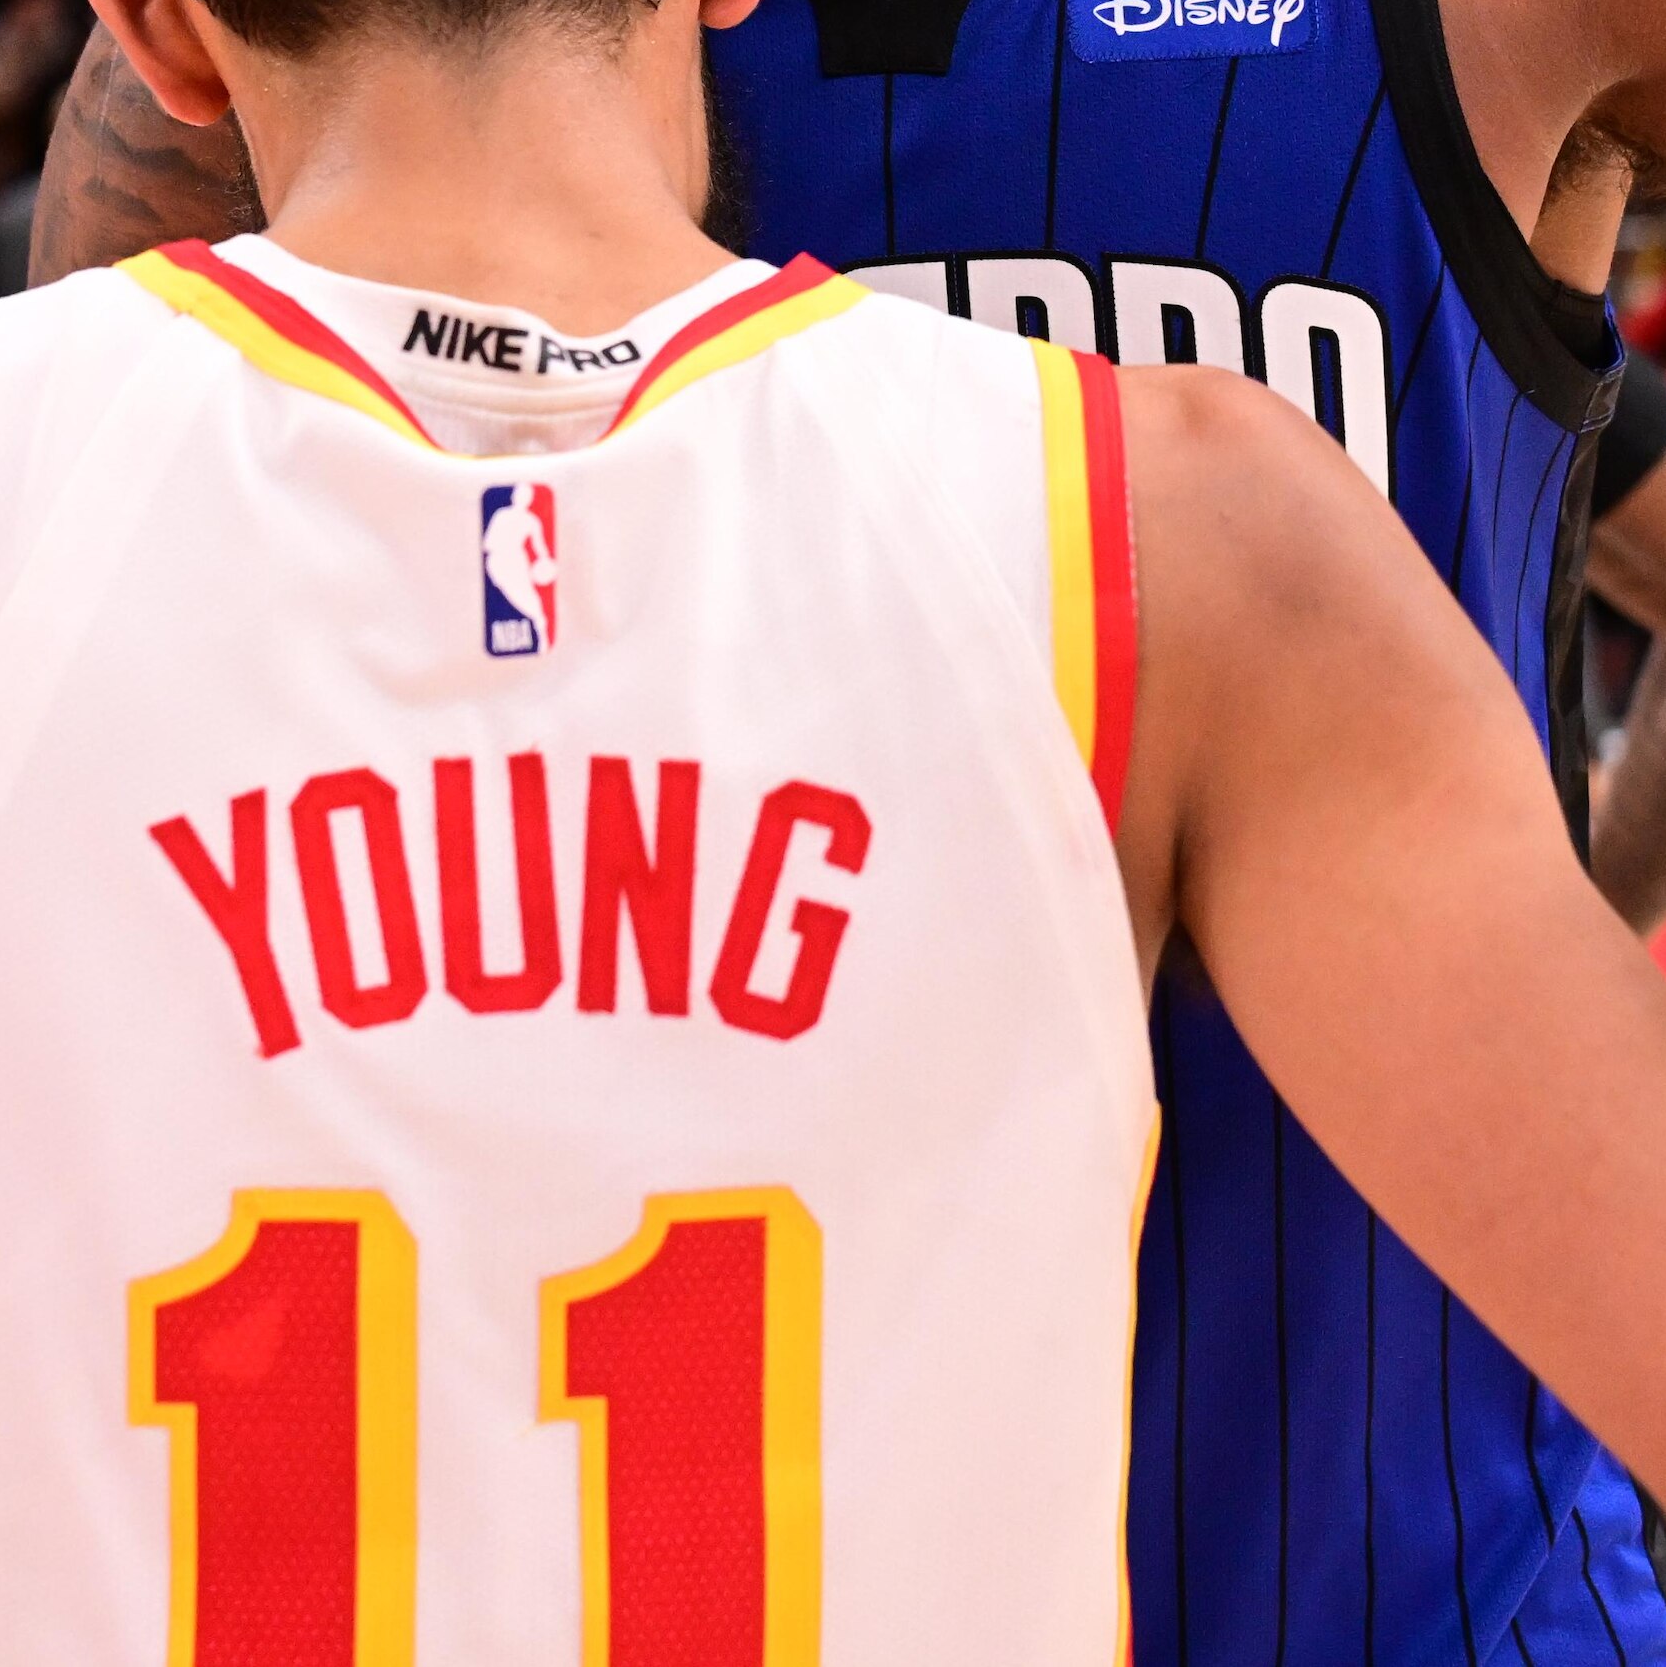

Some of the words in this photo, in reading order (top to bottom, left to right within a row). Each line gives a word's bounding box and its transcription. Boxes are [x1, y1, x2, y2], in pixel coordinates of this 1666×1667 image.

[402, 308, 529, 372] NIKE
[536, 334, 642, 375] PRO
[491, 617, 534, 653] NBA
[147, 750, 873, 1059] YOUNG
[125, 1183, 824, 1667] 11
